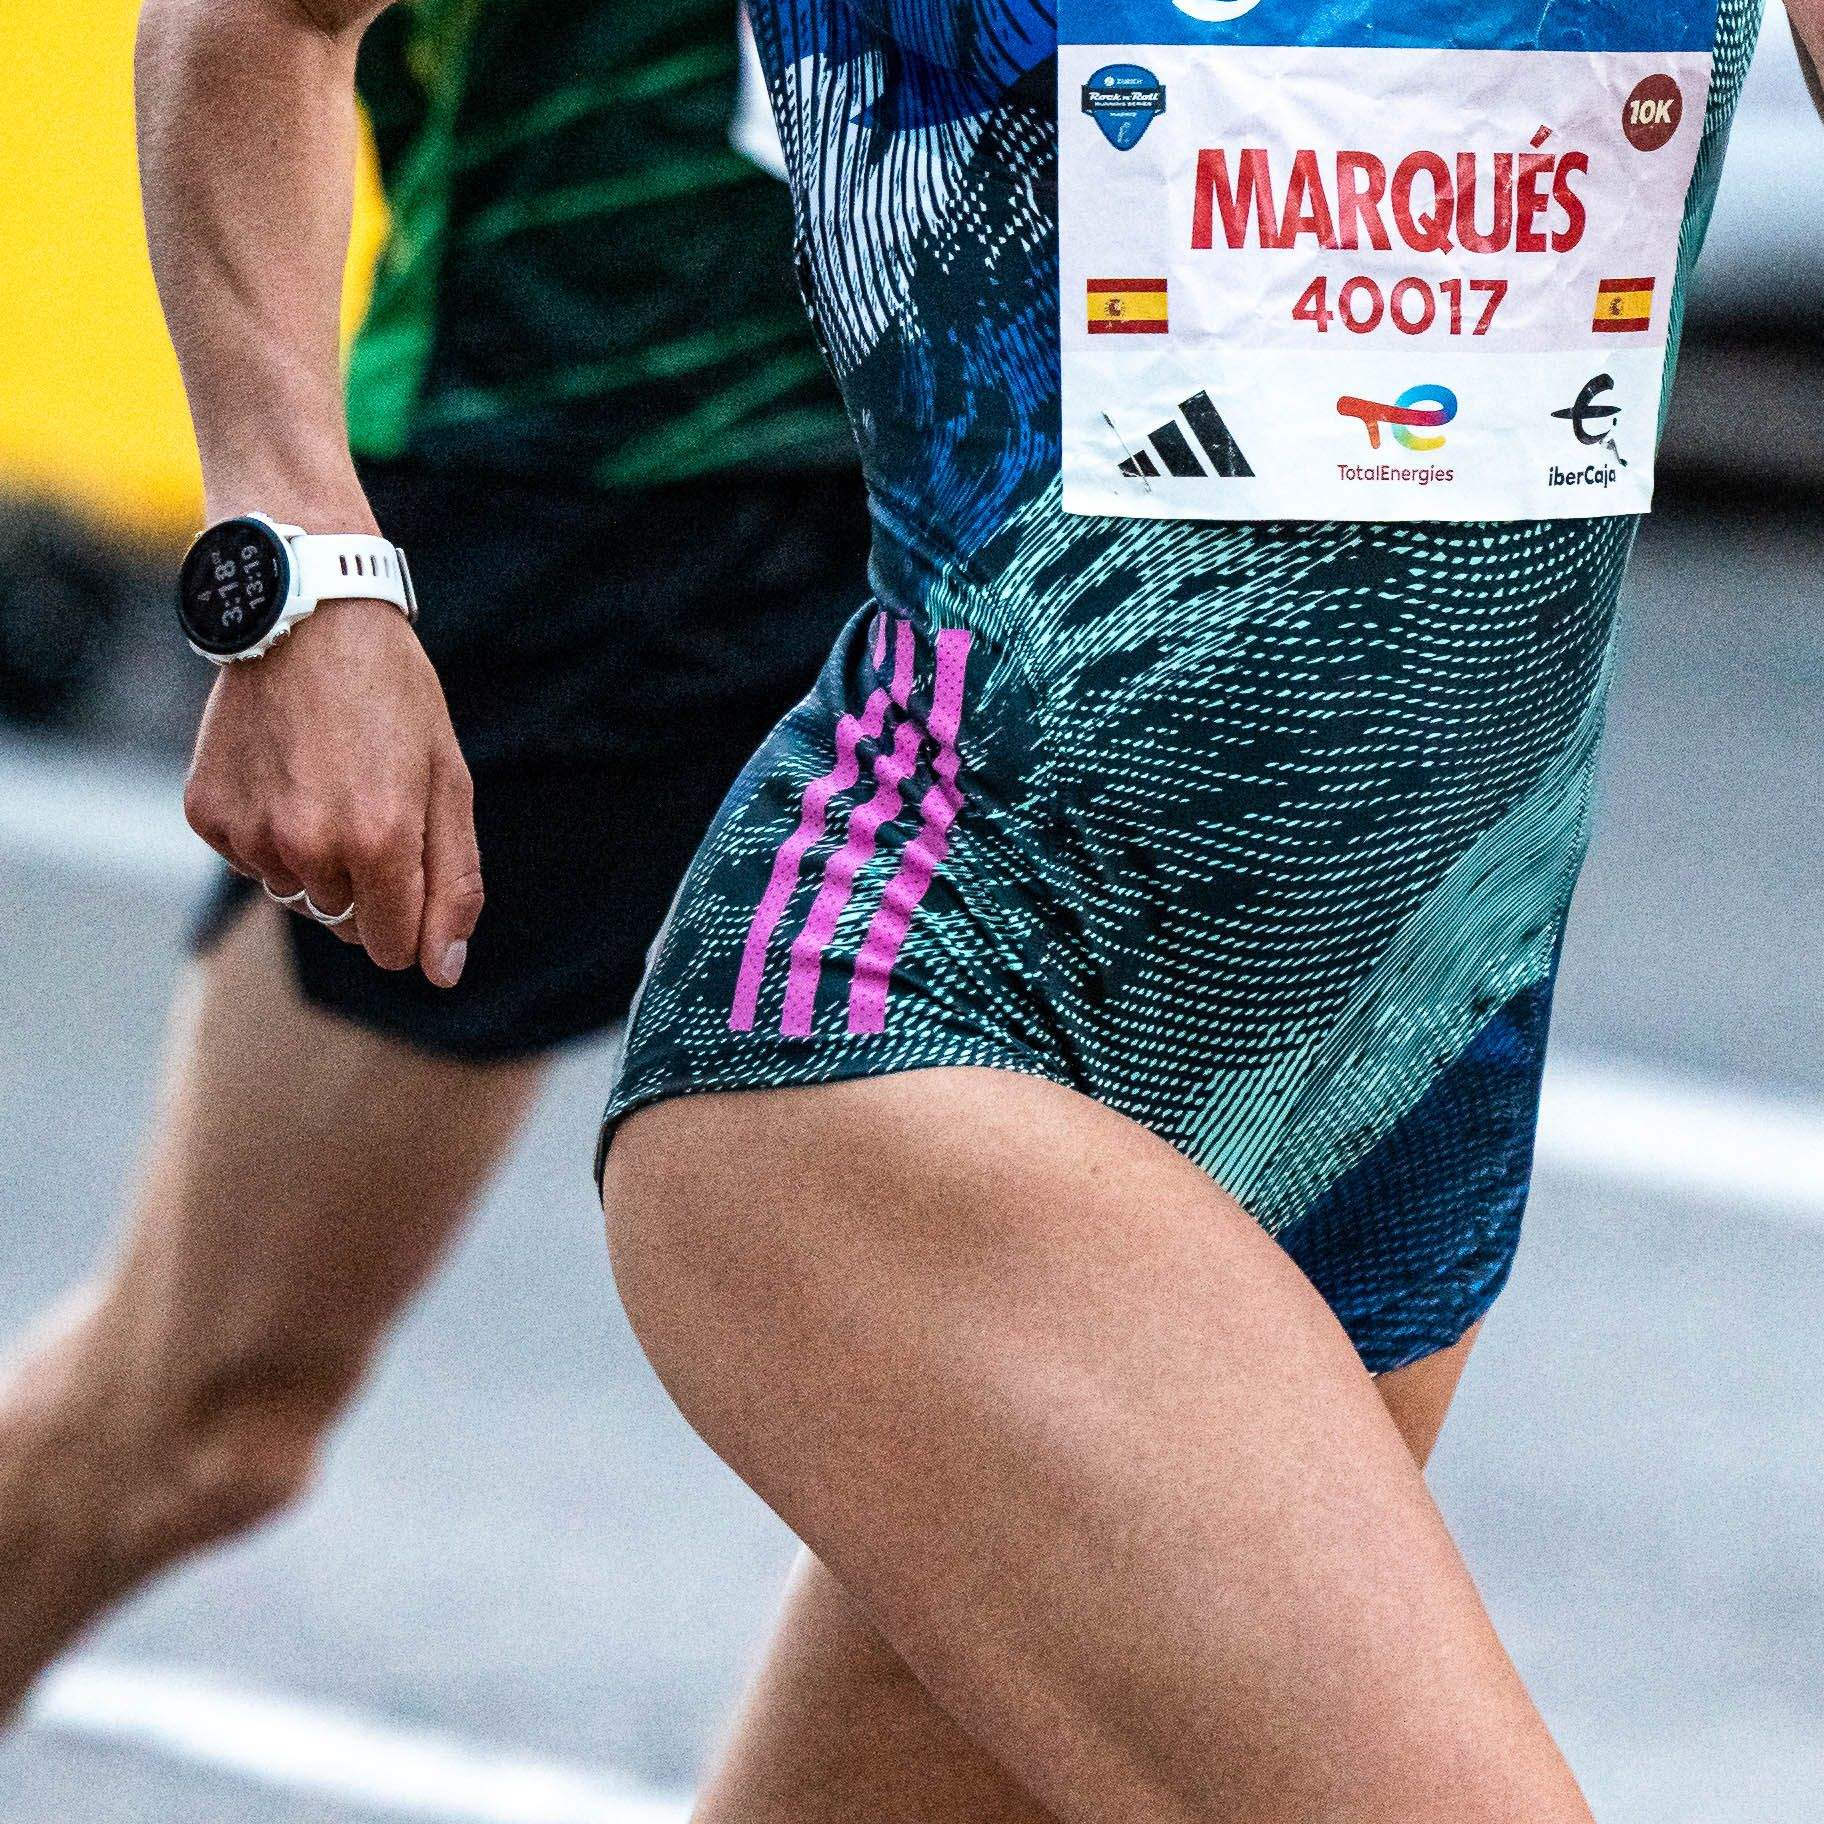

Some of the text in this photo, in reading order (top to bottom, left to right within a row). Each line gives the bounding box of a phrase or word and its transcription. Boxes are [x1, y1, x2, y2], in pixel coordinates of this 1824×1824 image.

[1630, 99, 1675, 125] 10K
[1191, 125, 1589, 255] MARQUÉS
[1292, 276, 1509, 336] 40017
[1336, 464, 1454, 485] TotalEnergies
[1549, 465, 1617, 488] iberCaja
